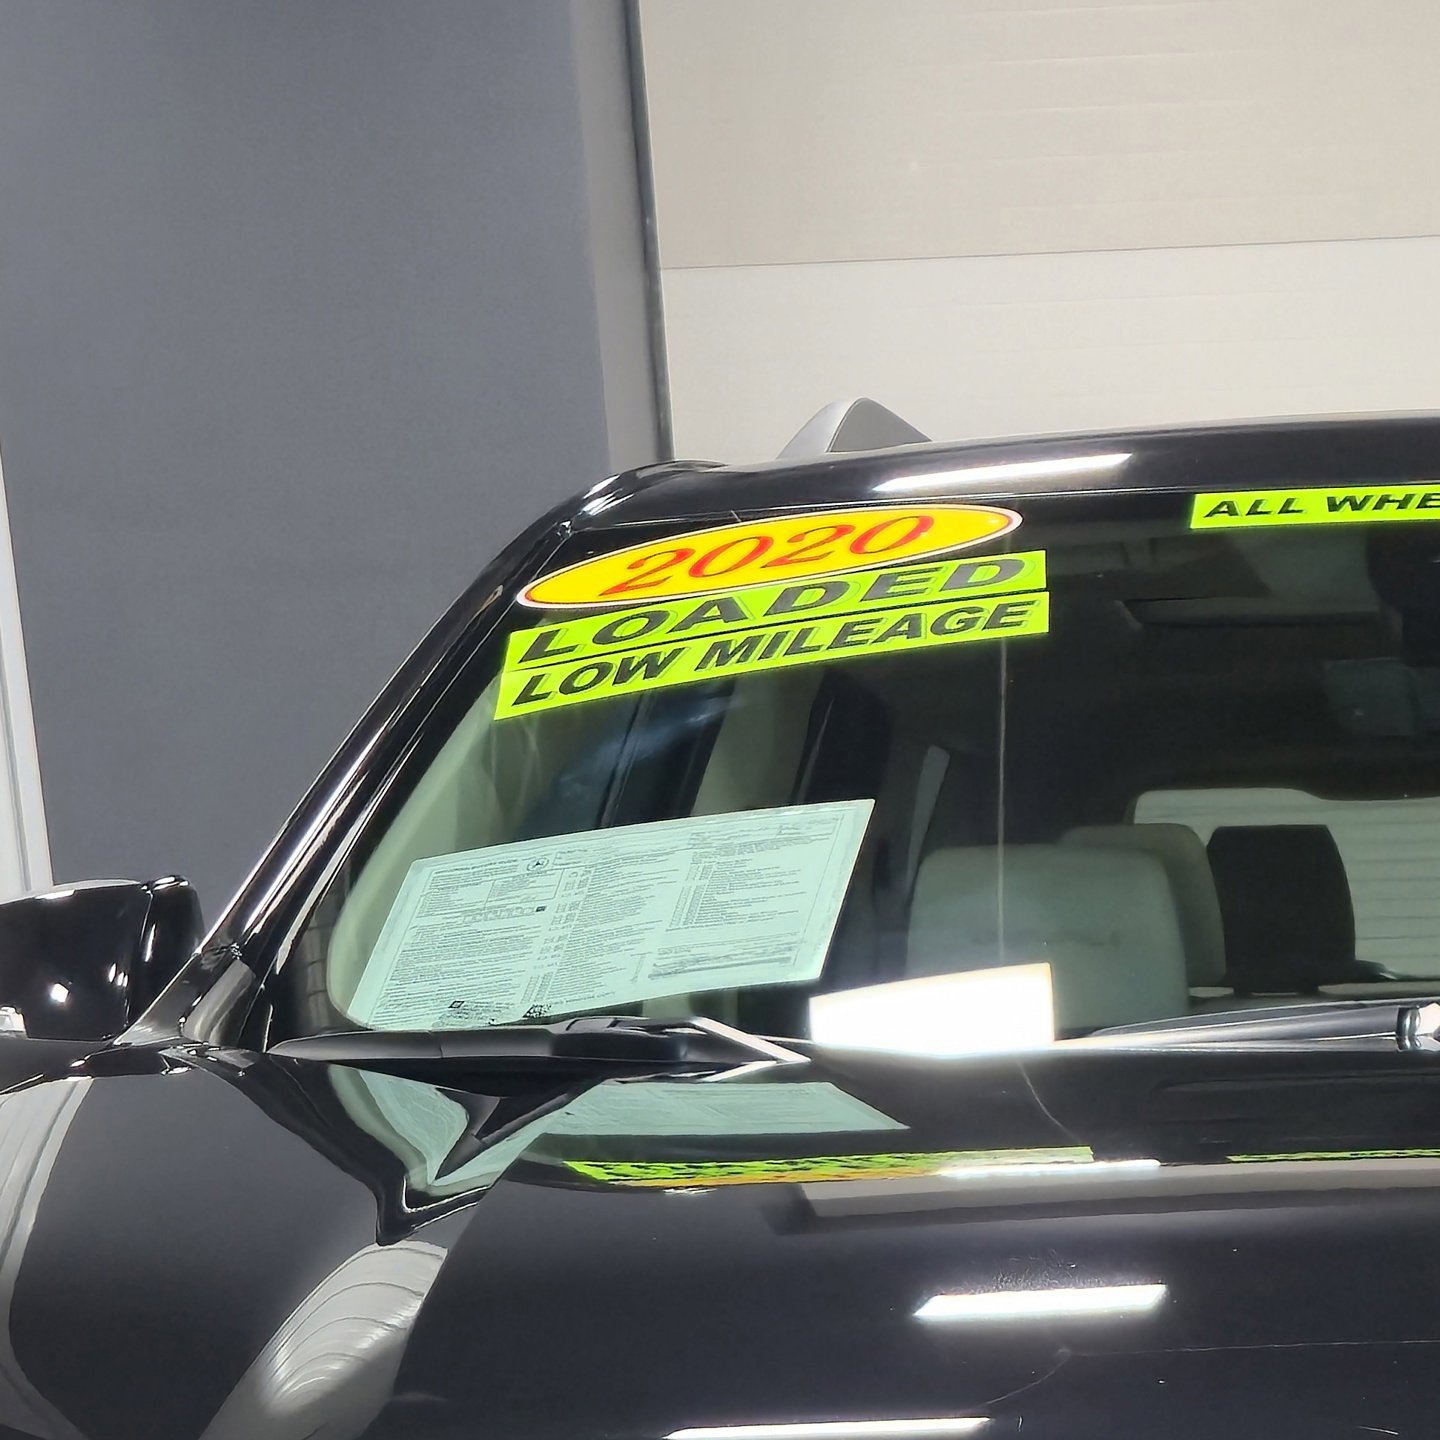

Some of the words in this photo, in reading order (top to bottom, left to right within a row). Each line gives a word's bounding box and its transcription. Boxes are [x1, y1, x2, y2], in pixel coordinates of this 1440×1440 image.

[1203, 497, 1304, 519] ALL
[599, 515, 935, 597] 2020
[511, 647, 687, 706] LOW
[694, 600, 1038, 672] MILEAGE
[517, 558, 1026, 664] LOADED
